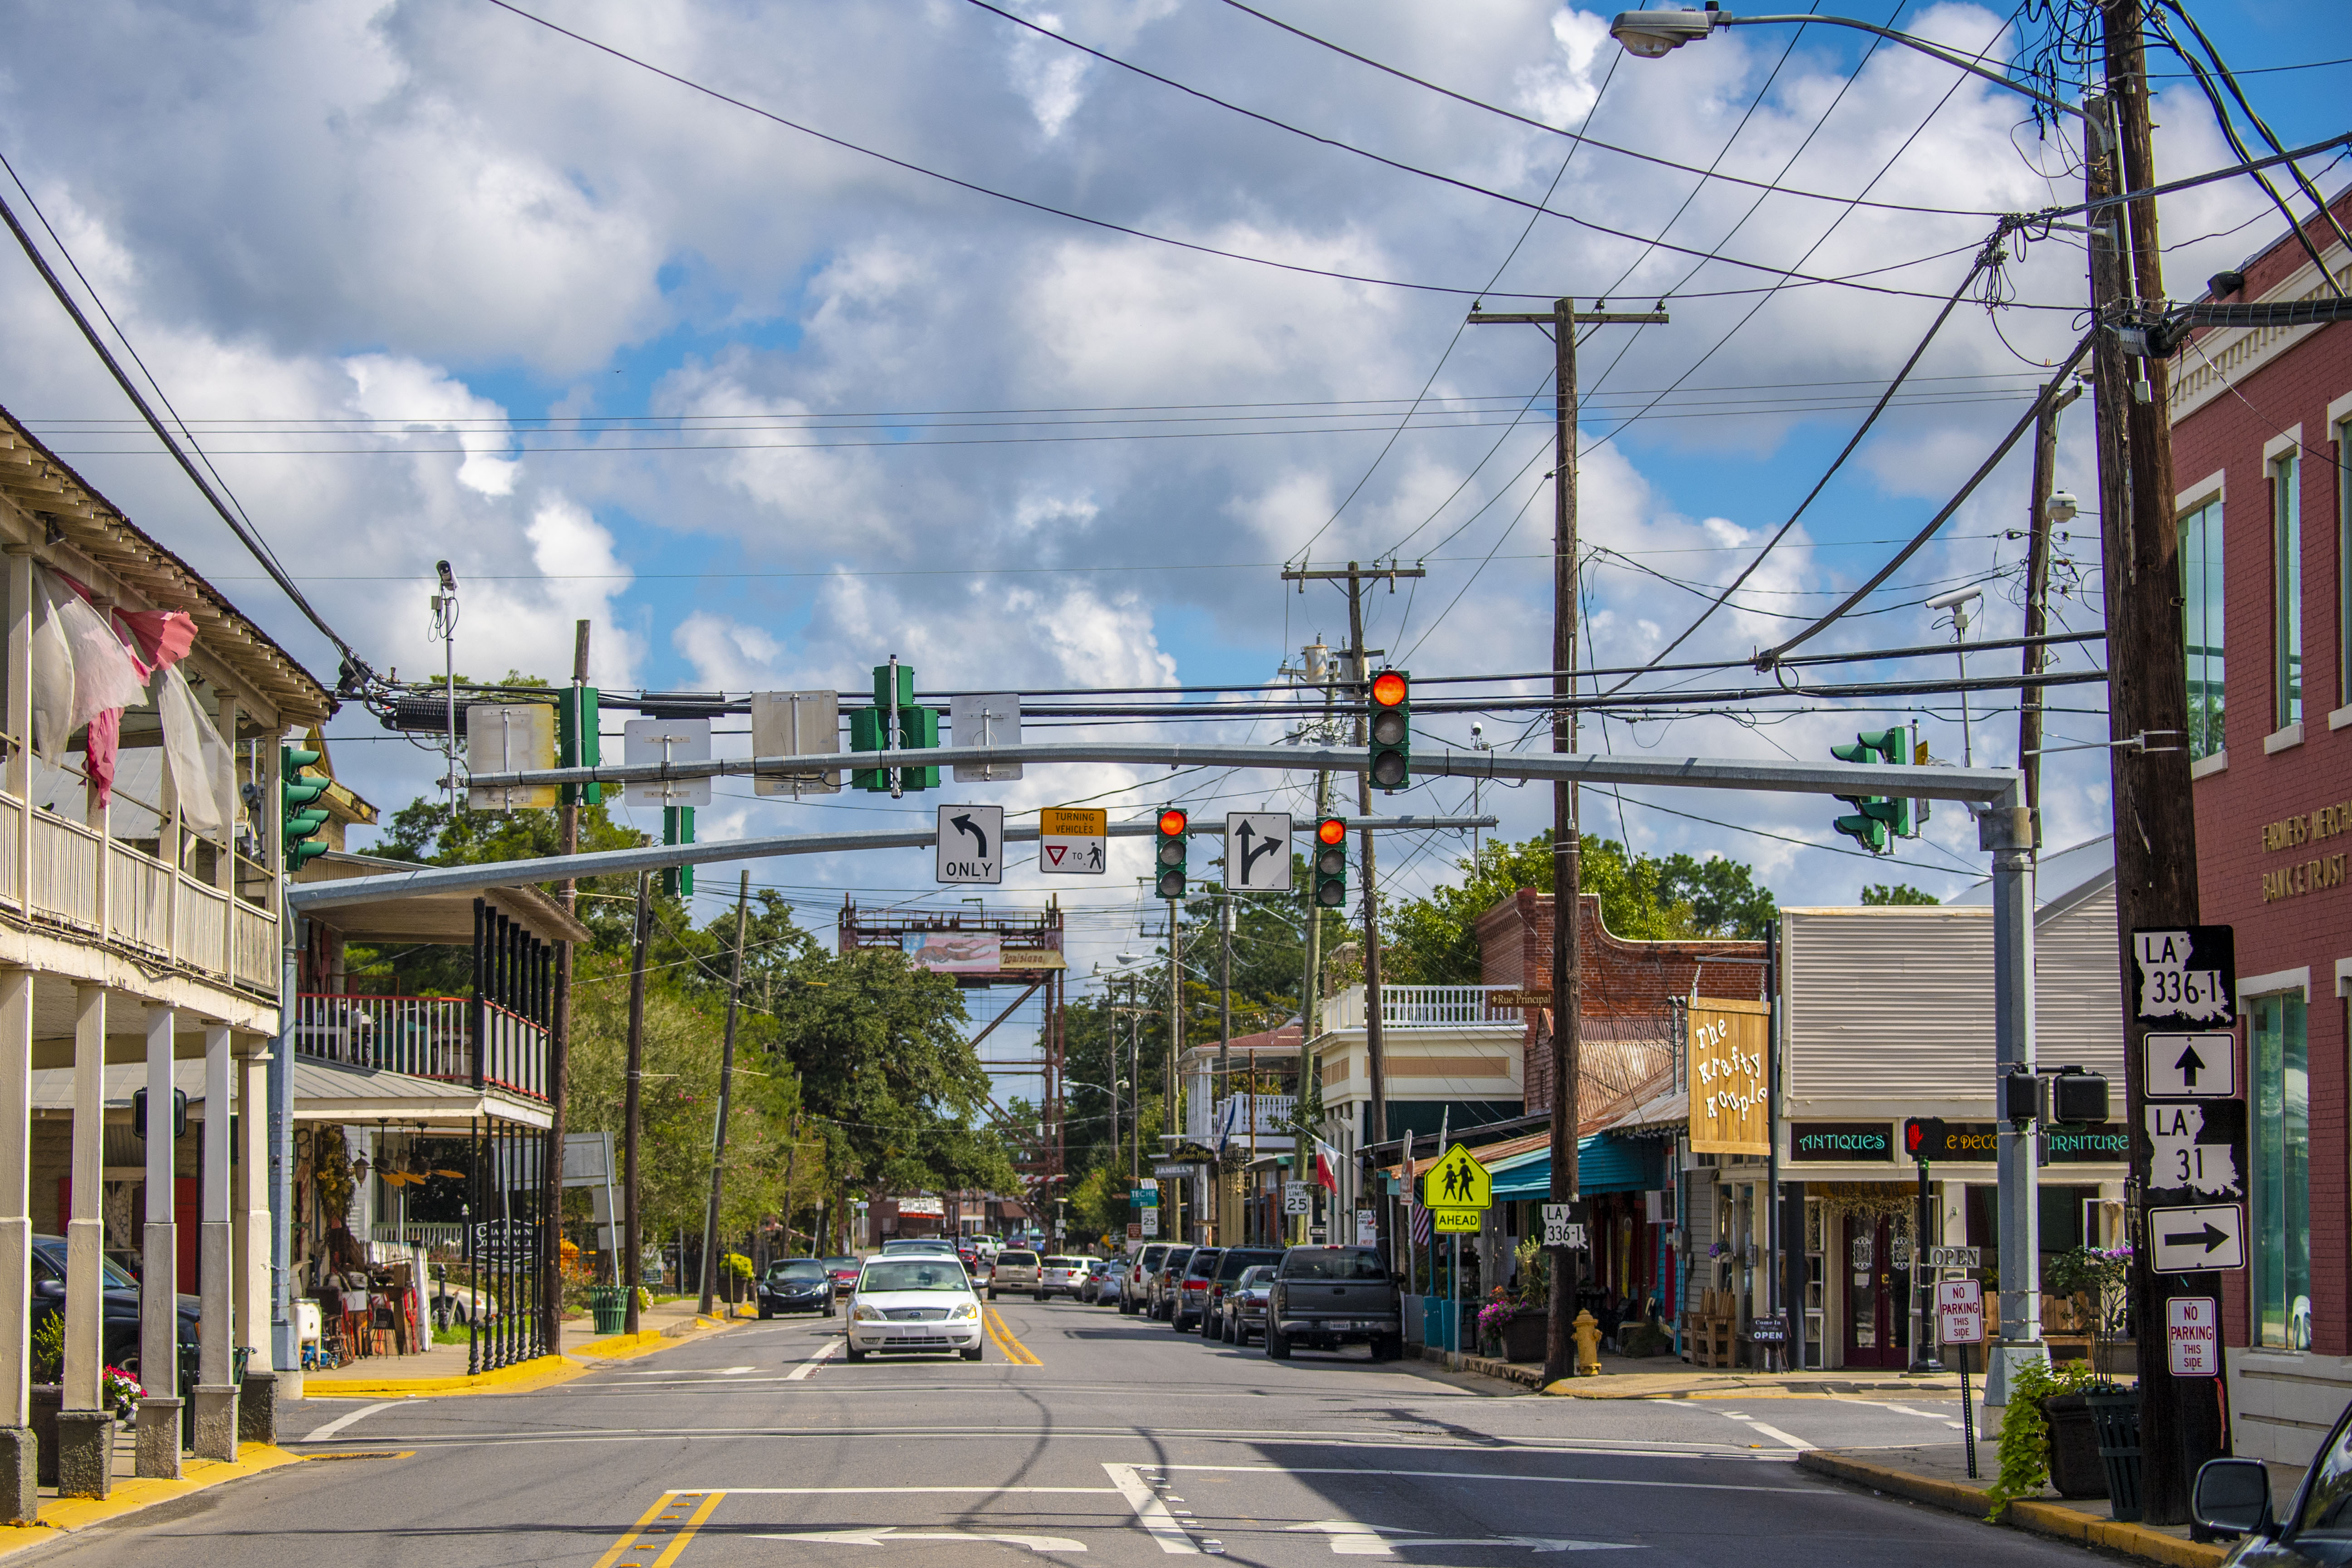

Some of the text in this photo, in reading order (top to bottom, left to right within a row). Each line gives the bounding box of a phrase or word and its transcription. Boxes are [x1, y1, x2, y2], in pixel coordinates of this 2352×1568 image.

[1055, 812, 1094, 821] TURNING
[1056, 825, 1093, 834] VEHICLES
[946, 862, 993, 877] ONLY
[2263, 867, 2294, 902] BANK
[2308, 853, 2347, 891] TRUST
[2145, 936, 2178, 964] LA
[1003, 952, 1043, 965] Louisiana
[2152, 971, 2216, 1004] 336-1
[1498, 994, 1551, 1007] Rue Principal
[1696, 1019, 1726, 1049] The
[1698, 1046, 1760, 1085] Krafty
[1706, 1079, 1768, 1121] Kouple
[2156, 1109, 2188, 1136] LA
[1799, 1134, 1886, 1151] ANTIQUES
[2048, 1134, 2129, 1152] URNITURE
[1155, 1165, 1194, 1174] JANELL'S
[2176, 1147, 2203, 1181] 31
[1287, 1198, 1307, 1210] 25
[1439, 1215, 1477, 1225] AHEAD
[1547, 1206, 1563, 1220] LA
[1143, 1217, 1156, 1225] 25
[1548, 1225, 1581, 1242] 336-1
[1933, 1249, 1978, 1265] OPEN
[1953, 1287, 1965, 1299] NO
[1942, 1302, 1978, 1316] PARKING
[2184, 1306, 2198, 1321] NO
[1953, 1317, 1969, 1326] THIS
[1754, 1331, 1783, 1339] OPEN
[1954, 1328, 1970, 1337] SIDE
[2171, 1326, 2213, 1341] PARKING
[2183, 1344, 2201, 1355] THIS
[2184, 1357, 2203, 1367] SIDE
